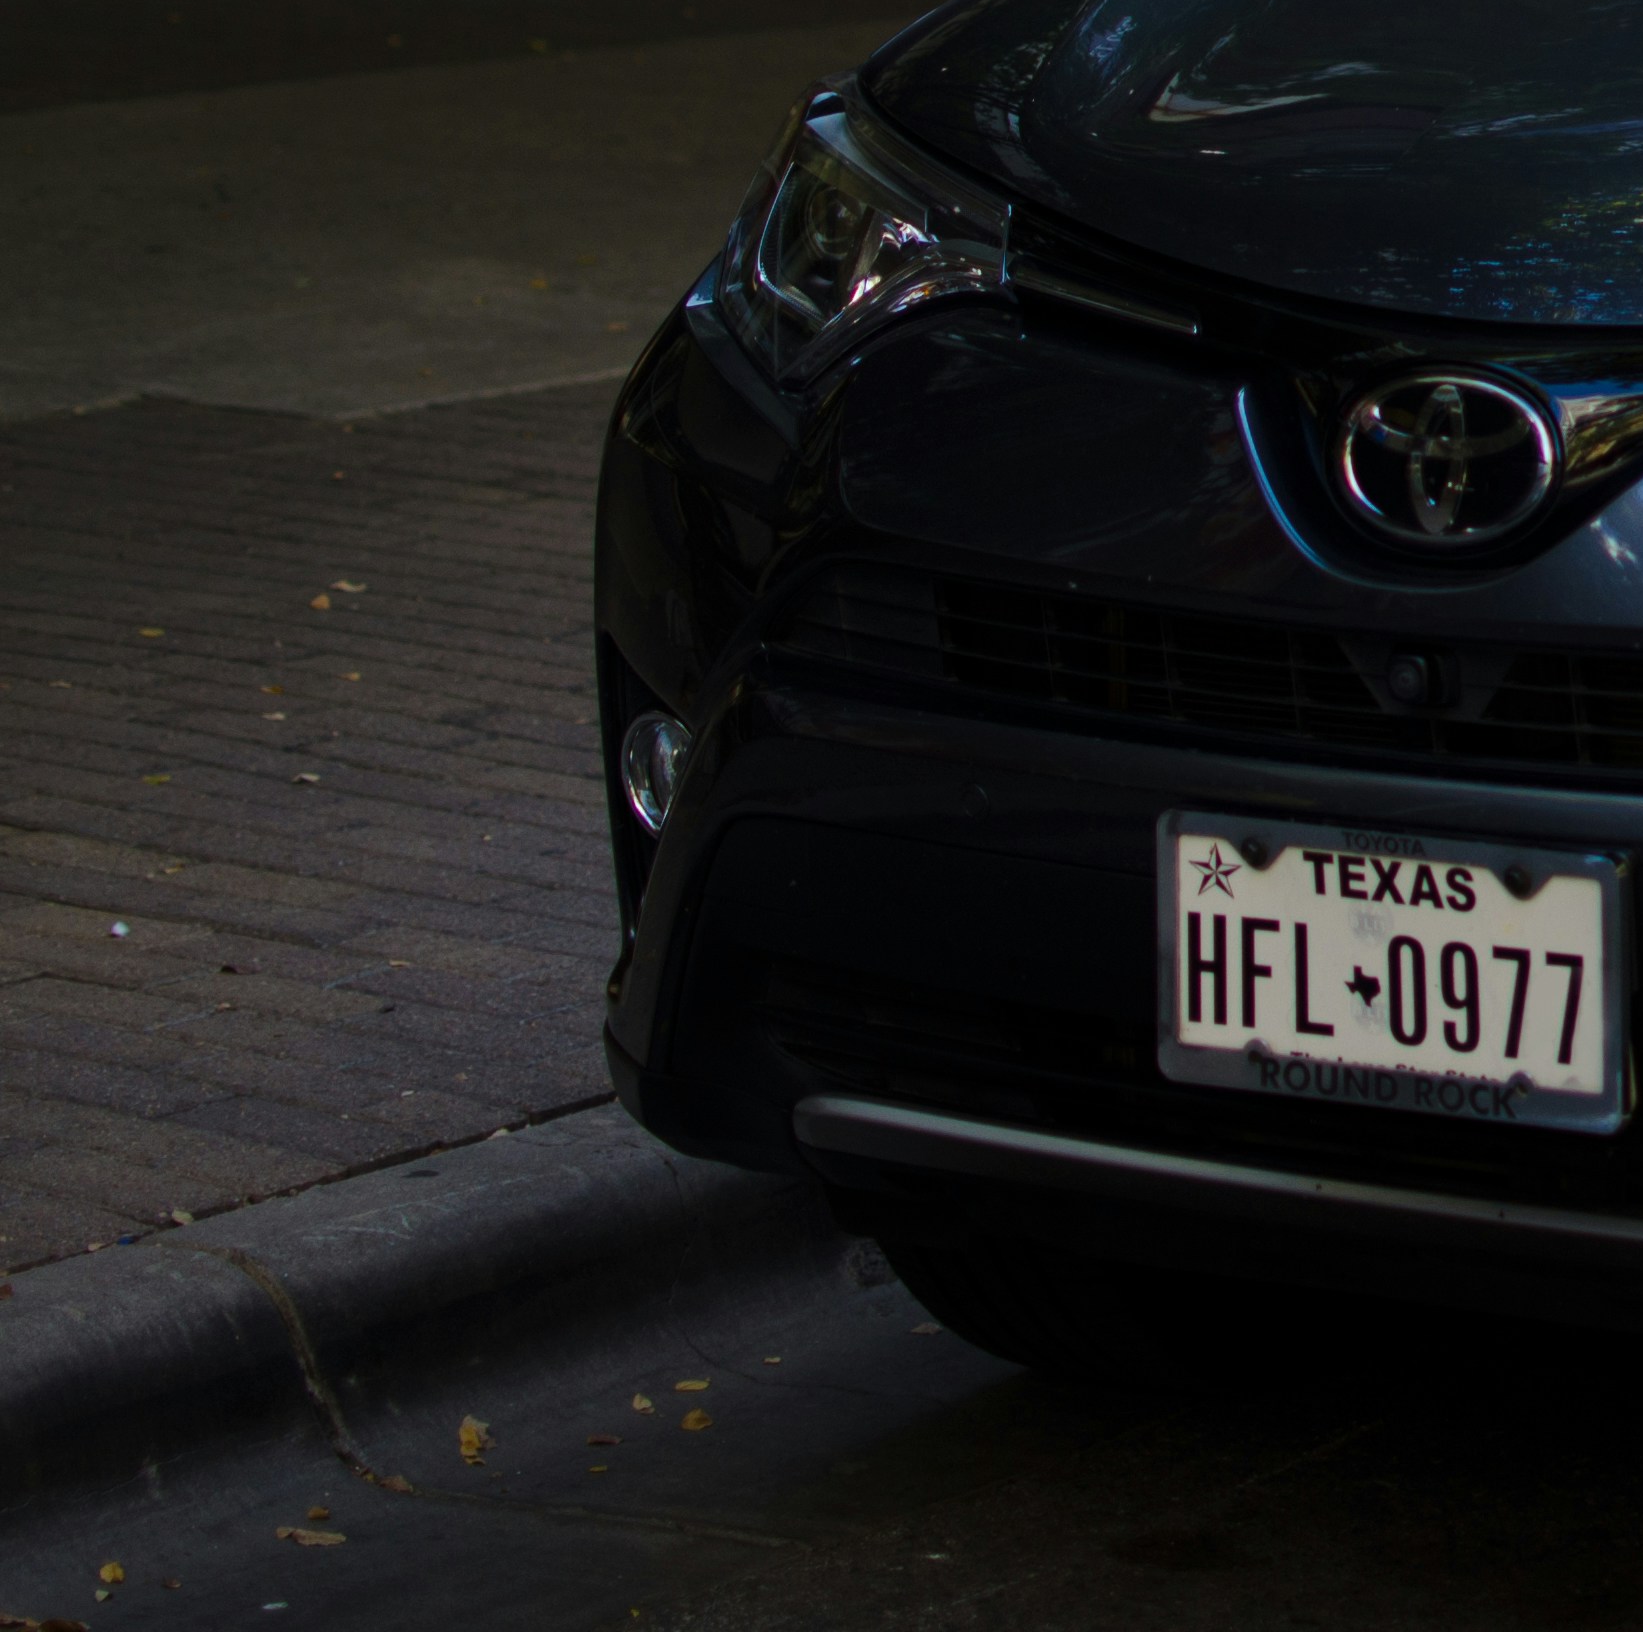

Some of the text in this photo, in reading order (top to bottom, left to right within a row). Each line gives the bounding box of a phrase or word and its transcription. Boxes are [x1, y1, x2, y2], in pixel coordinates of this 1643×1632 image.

[1341, 831, 1427, 857] TOYOTA
[1302, 850, 1477, 912] TEXAS
[1257, 1055, 1399, 1103] ROUND
[1414, 1076, 1519, 1119] ROCK
